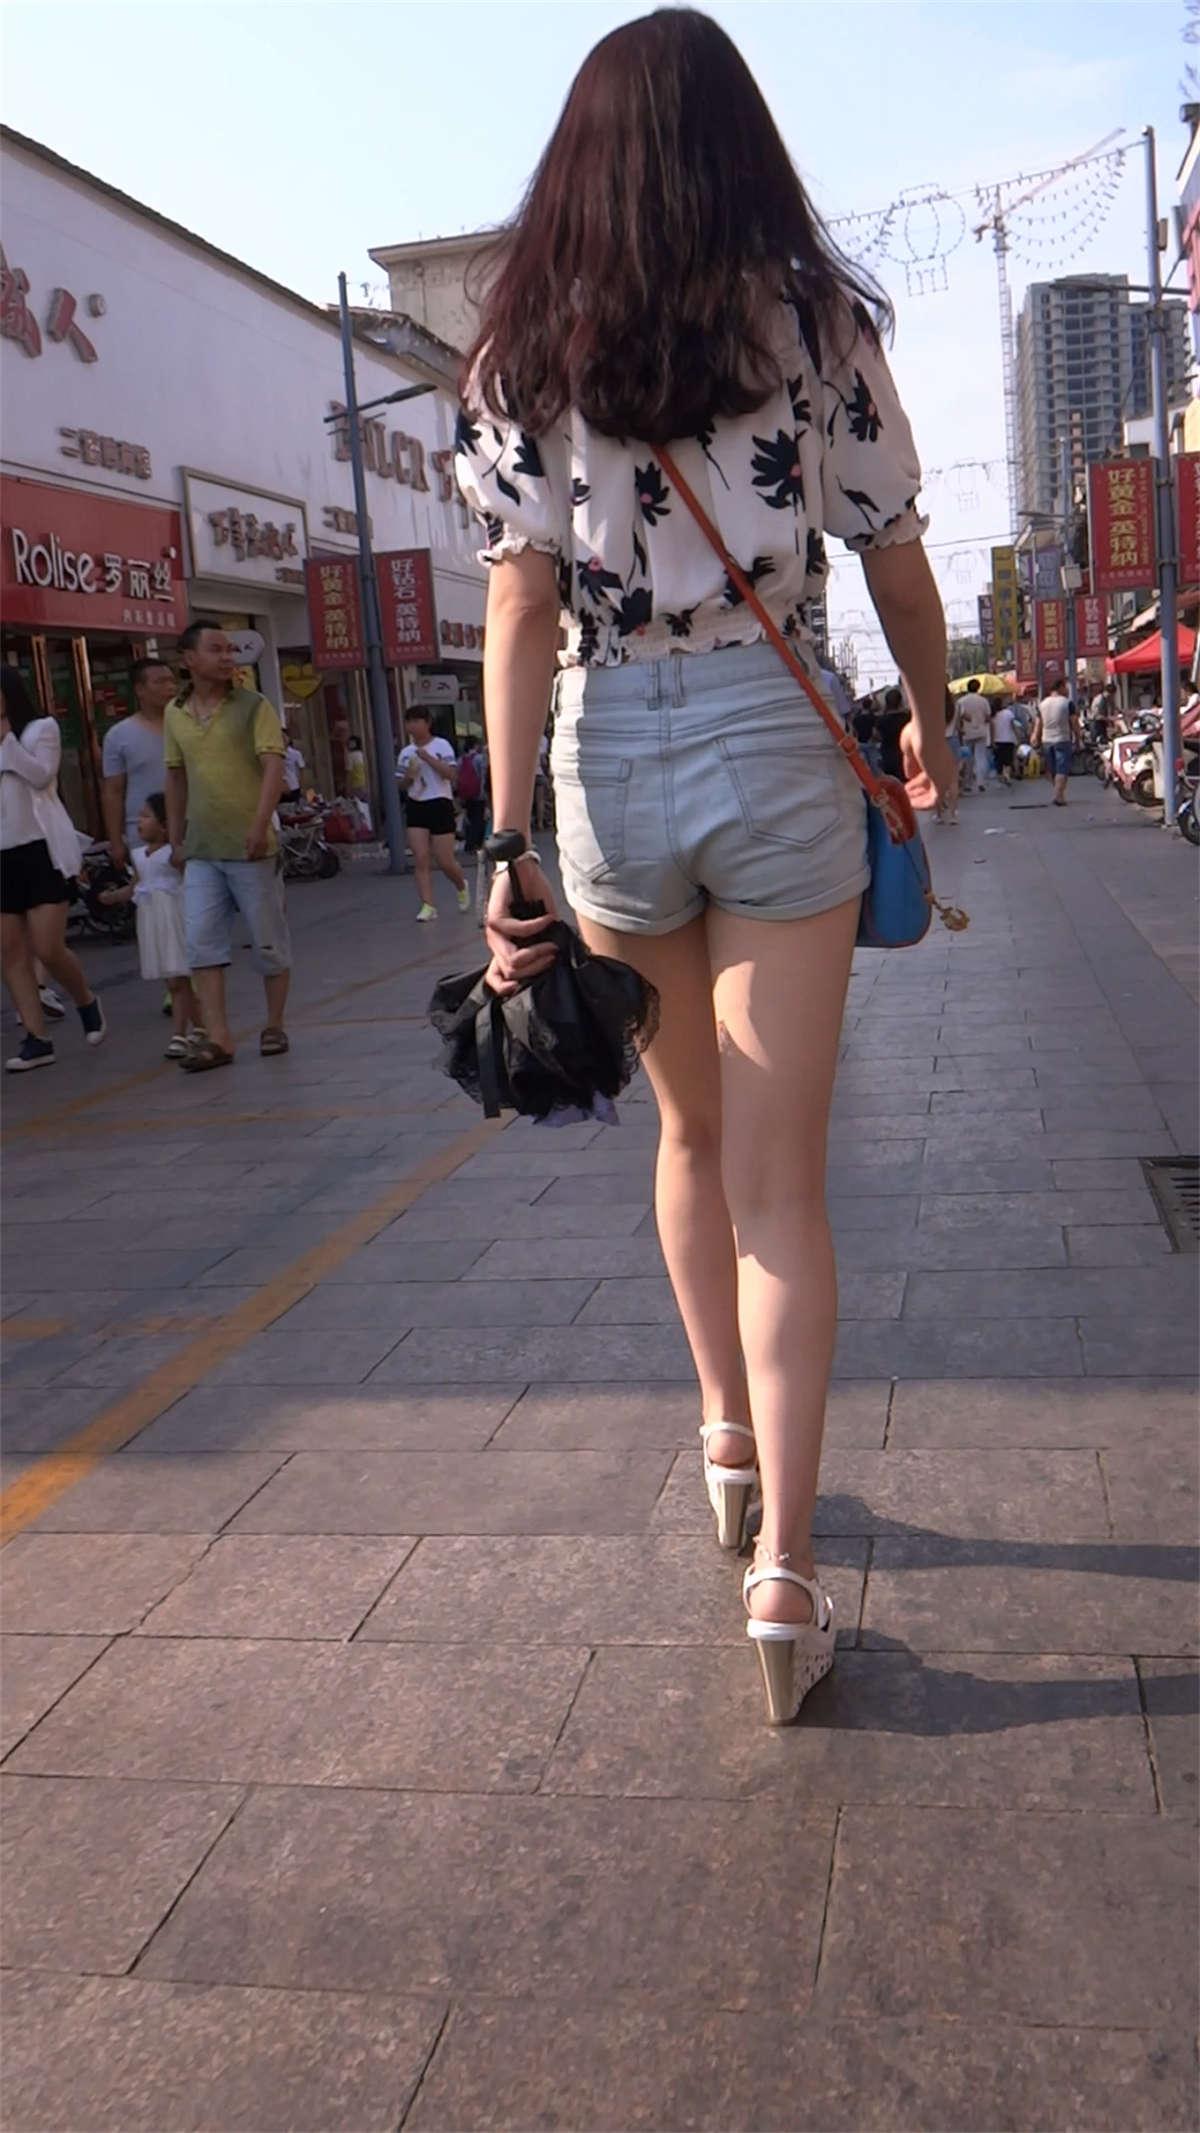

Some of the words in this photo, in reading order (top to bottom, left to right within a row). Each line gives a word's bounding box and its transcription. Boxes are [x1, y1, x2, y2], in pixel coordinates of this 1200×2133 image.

[1108, 468, 1138, 567] 好黄金英特纳
[12, 528, 97, 593] Rolise
[104, 553, 175, 602] 罗丽丝
